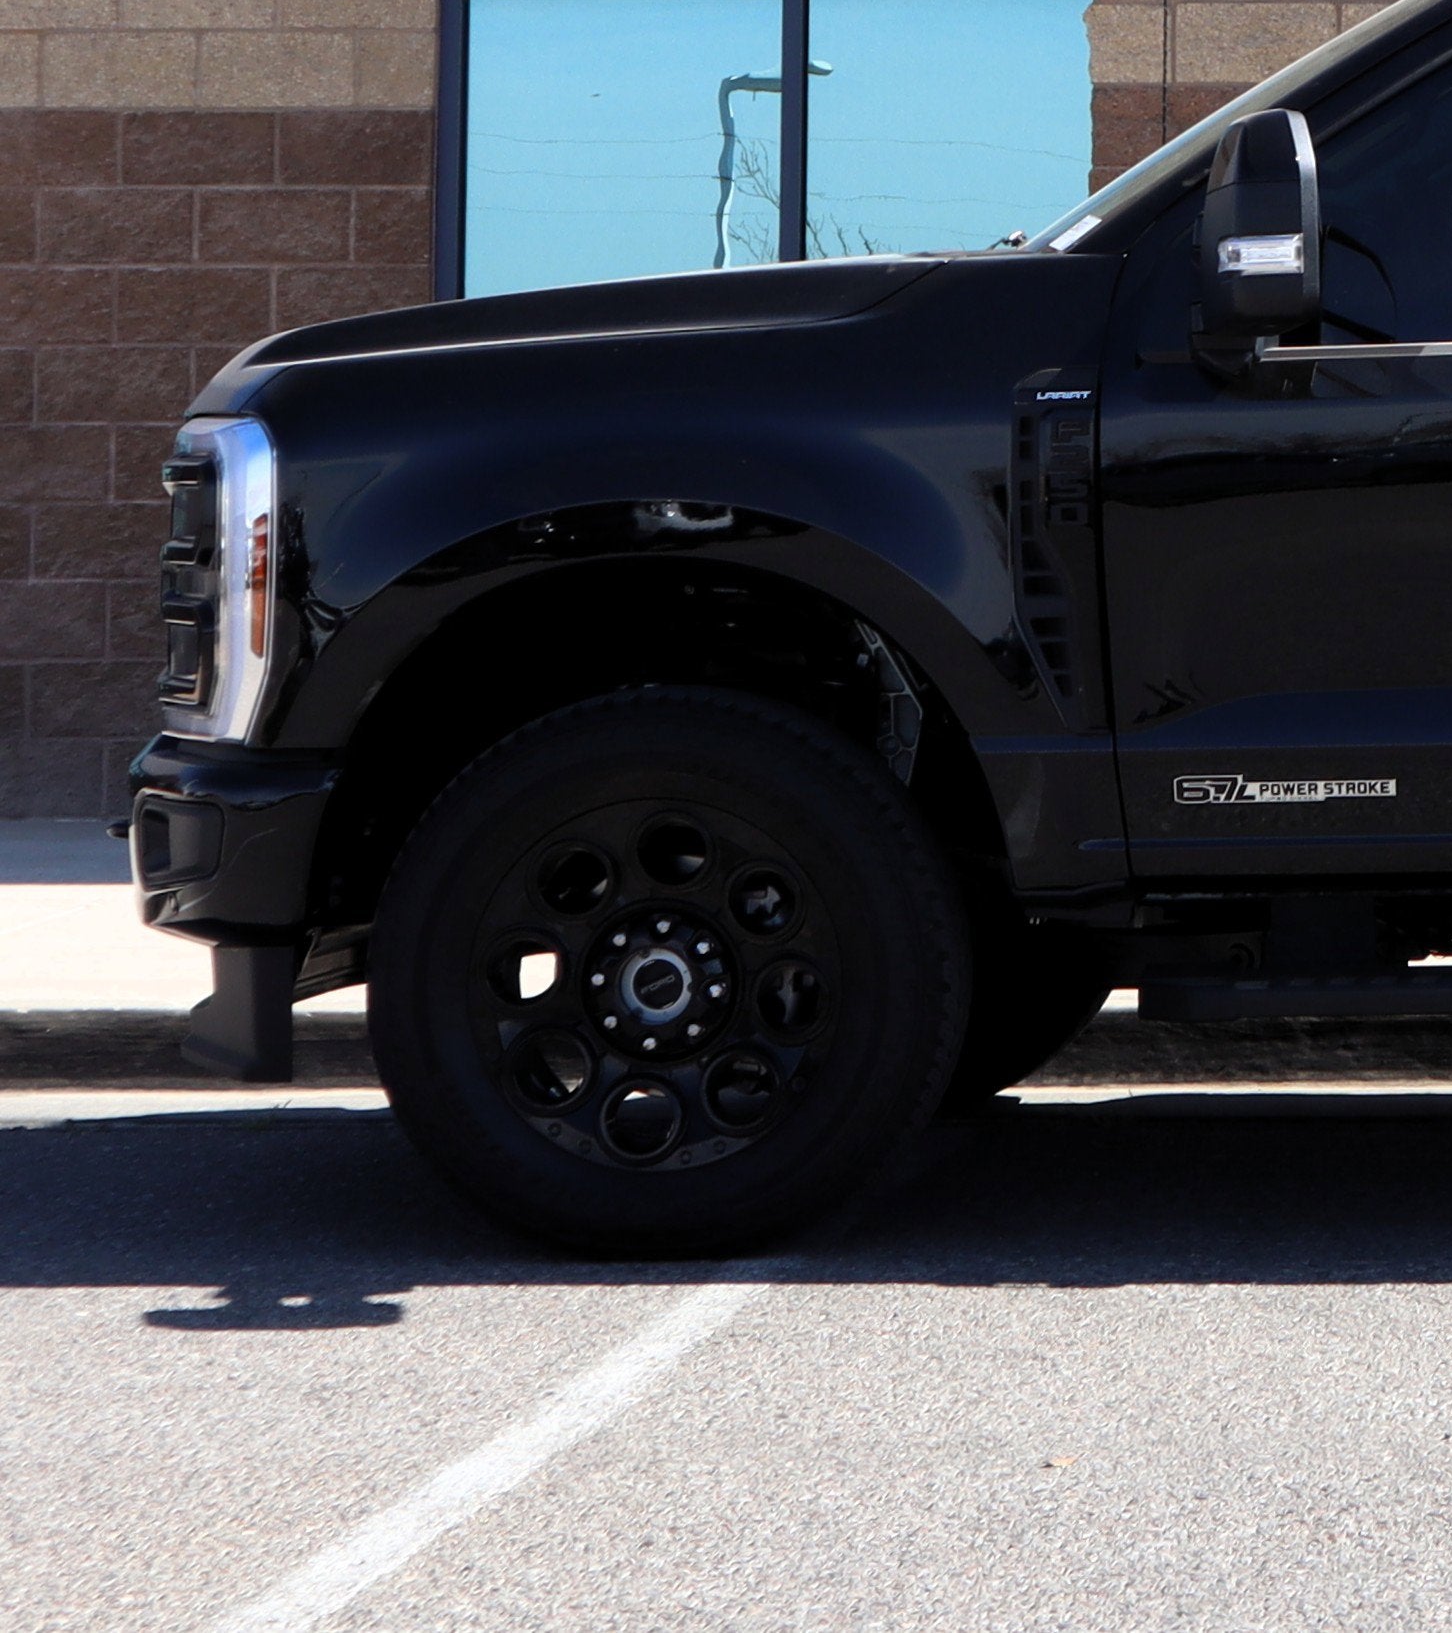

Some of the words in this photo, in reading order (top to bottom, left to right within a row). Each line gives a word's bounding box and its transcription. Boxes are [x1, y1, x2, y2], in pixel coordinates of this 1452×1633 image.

[1036, 390, 1092, 401] LARIAT
[1174, 775, 1257, 803] 6.7L
[1259, 782, 1318, 796] POWER
[1323, 781, 1391, 794] STROKE
